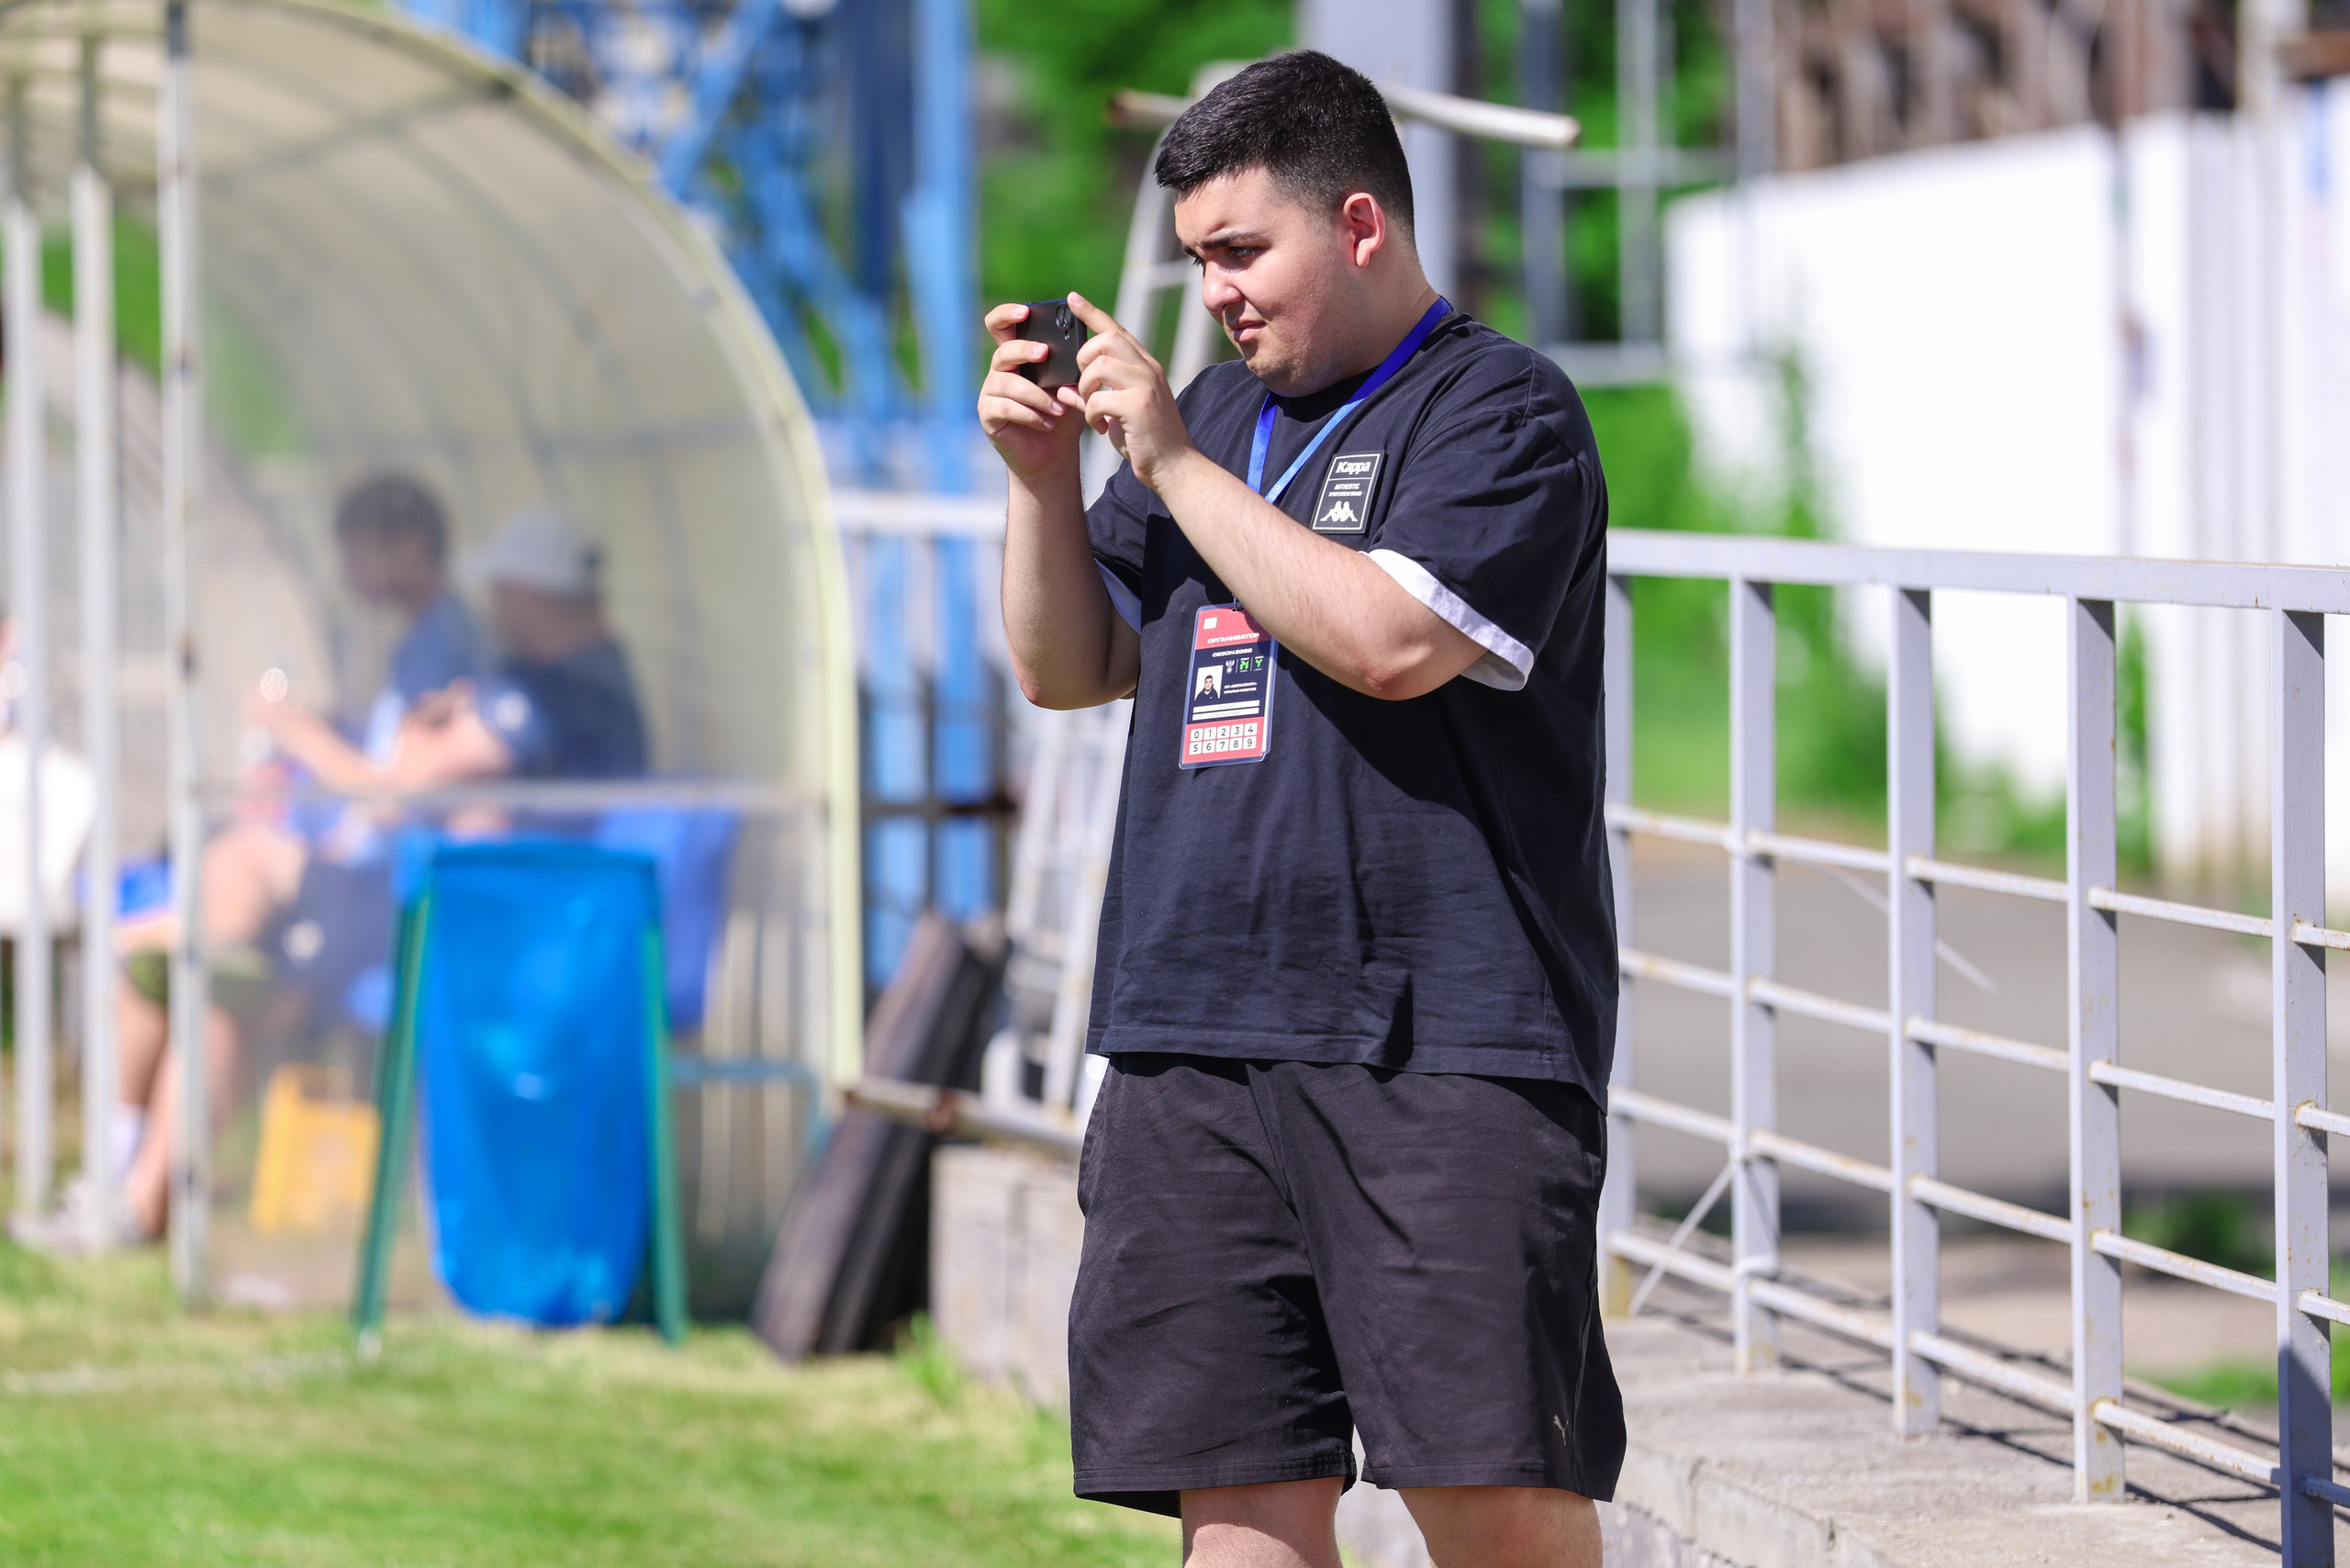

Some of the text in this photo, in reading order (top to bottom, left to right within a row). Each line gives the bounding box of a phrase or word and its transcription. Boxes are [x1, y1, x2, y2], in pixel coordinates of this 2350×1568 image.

[1336, 461, 1371, 475] Kappa
[1207, 633, 1259, 644] ОРГАНИЗАТОР
[1194, 731, 1200, 739] 0
[1221, 728, 1226, 736] 2
[1206, 743, 1211, 751] 6
